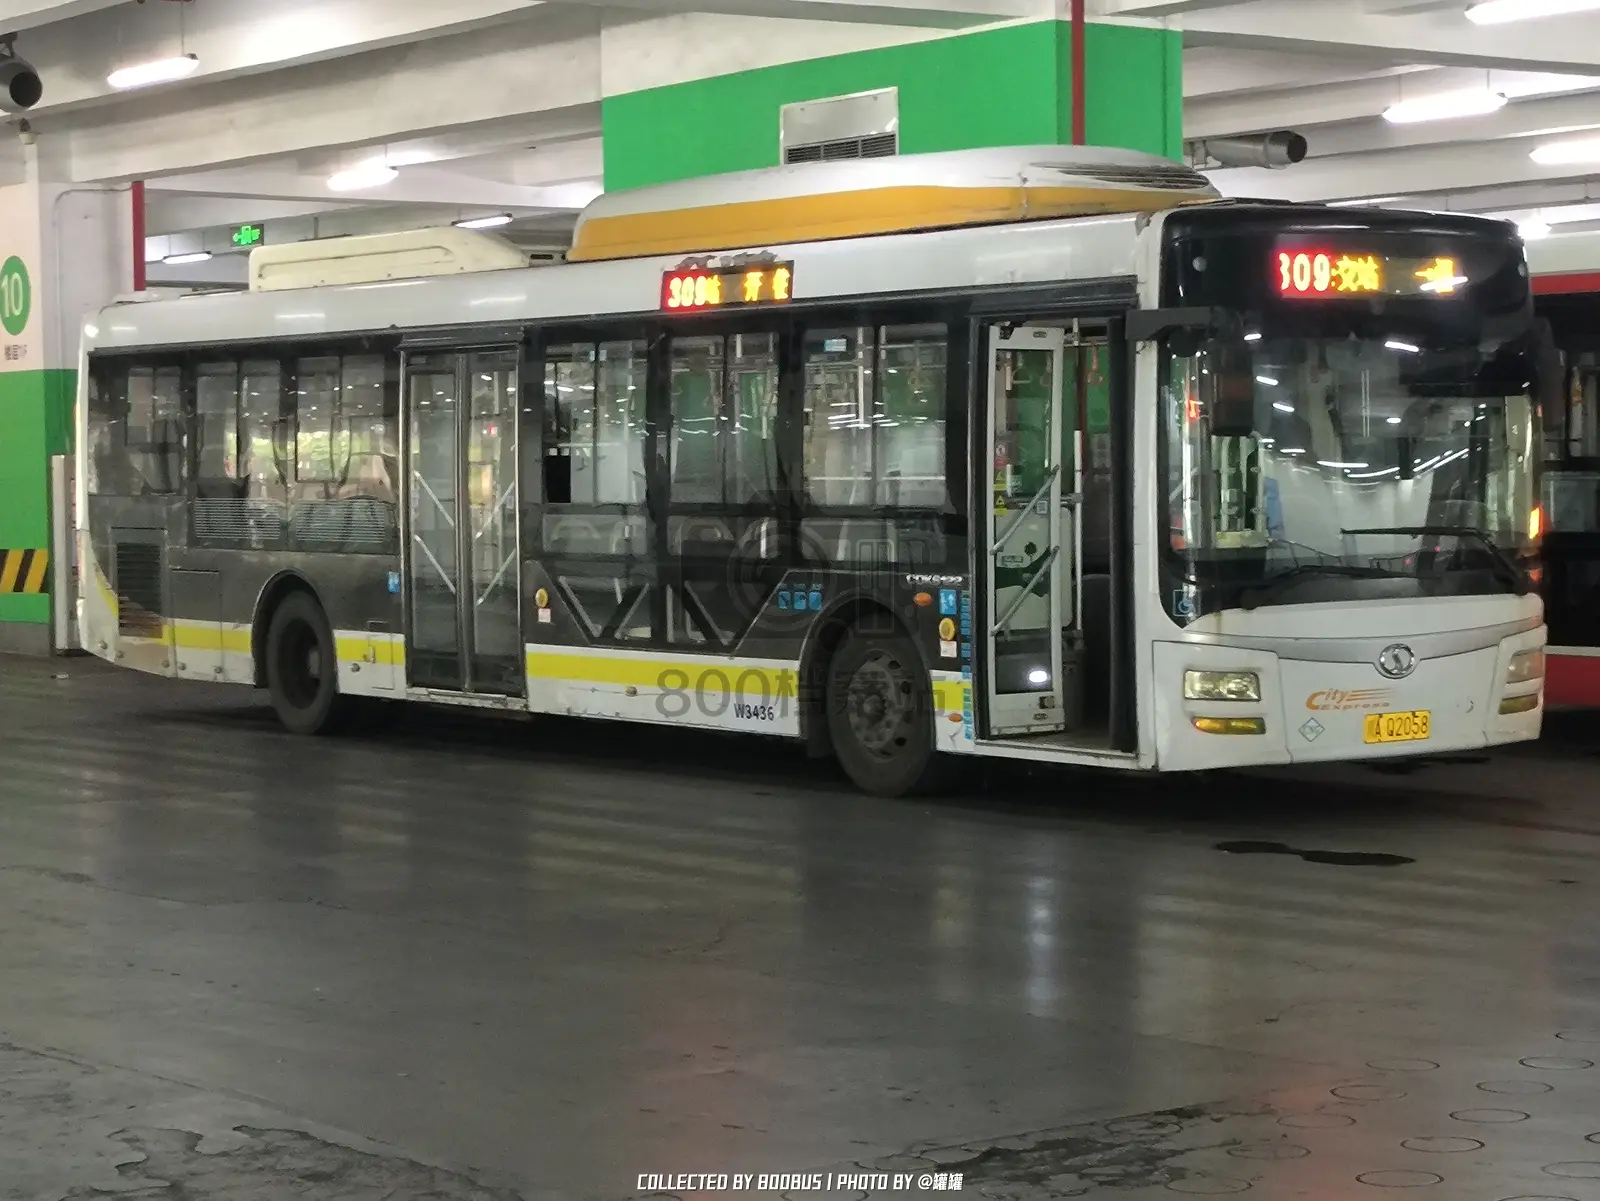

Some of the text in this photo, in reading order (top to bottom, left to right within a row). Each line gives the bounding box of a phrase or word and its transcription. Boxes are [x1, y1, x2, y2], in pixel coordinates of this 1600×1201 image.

[1, 272, 23, 318] 10
[1305, 687, 1349, 711] City
[733, 702, 775, 721] W3436
[1386, 714, 1429, 738] Q2058
